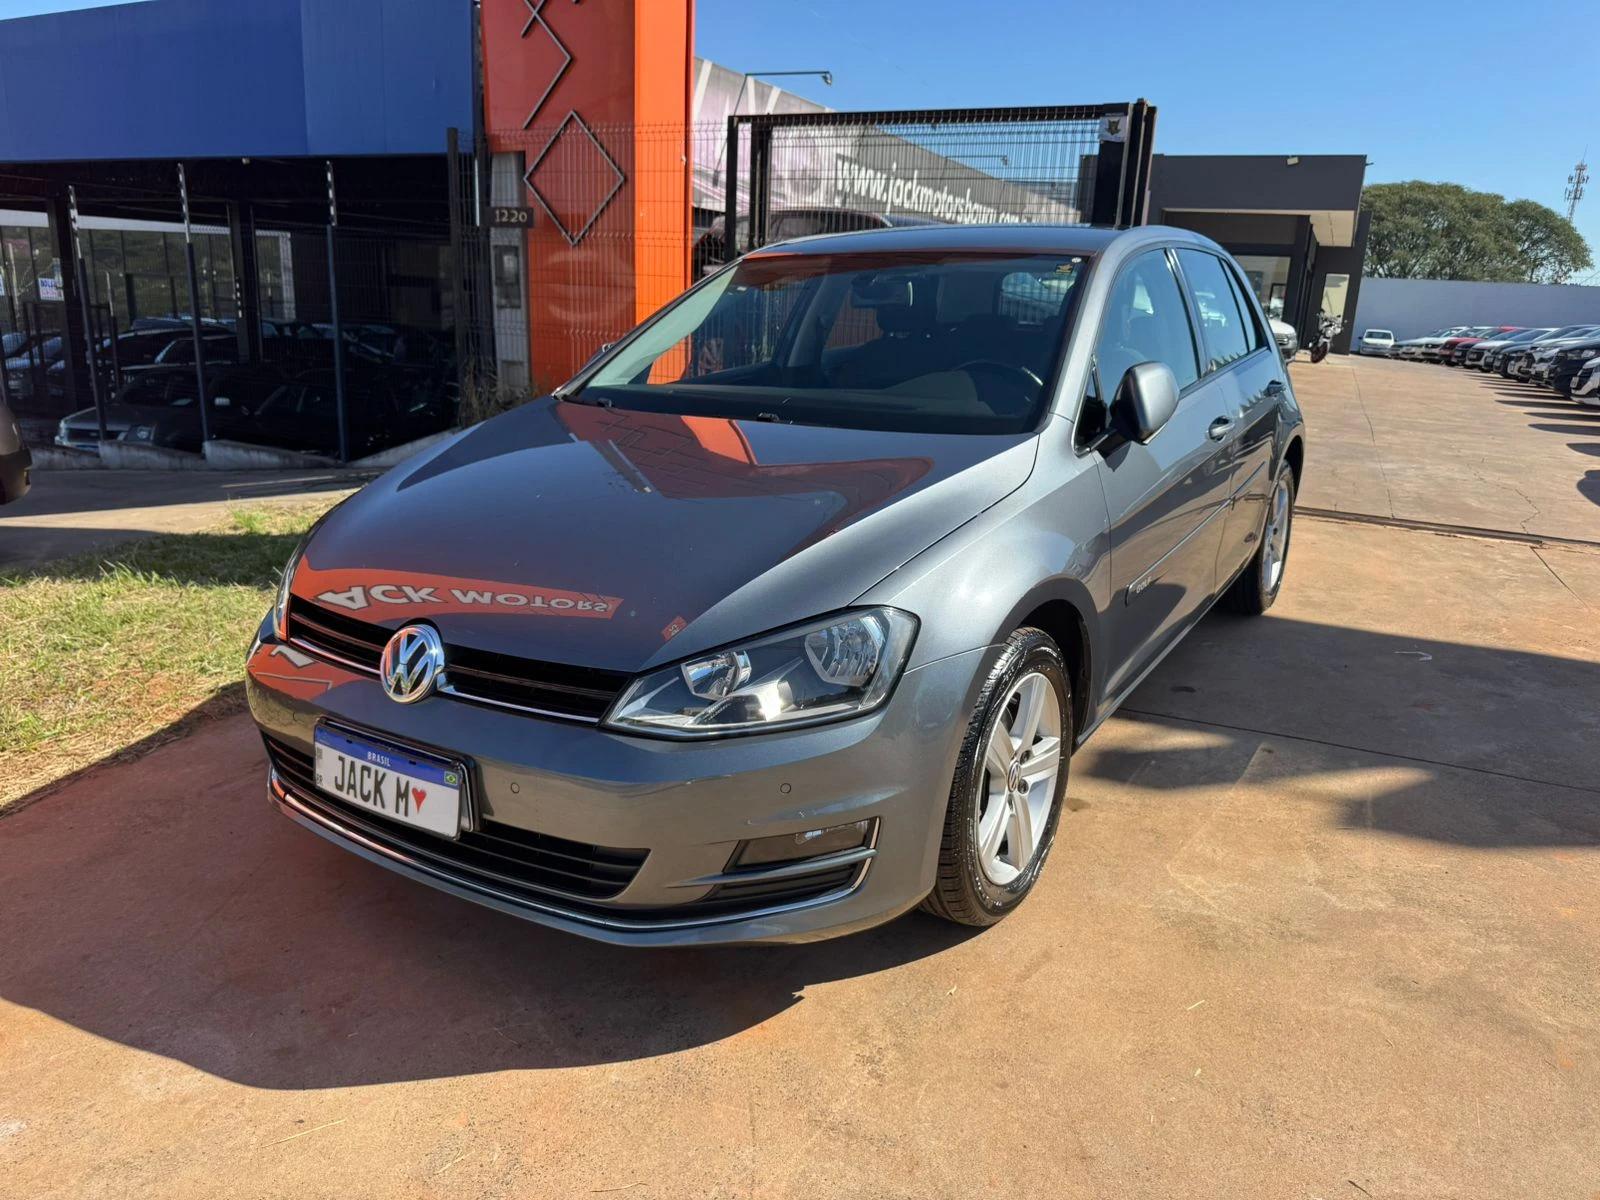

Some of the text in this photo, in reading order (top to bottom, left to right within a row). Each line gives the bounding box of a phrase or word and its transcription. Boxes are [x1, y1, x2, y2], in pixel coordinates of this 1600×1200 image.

[495, 209, 528, 223] 1220
[367, 751, 391, 767] BRASIL
[334, 755, 410, 818] JACK M
